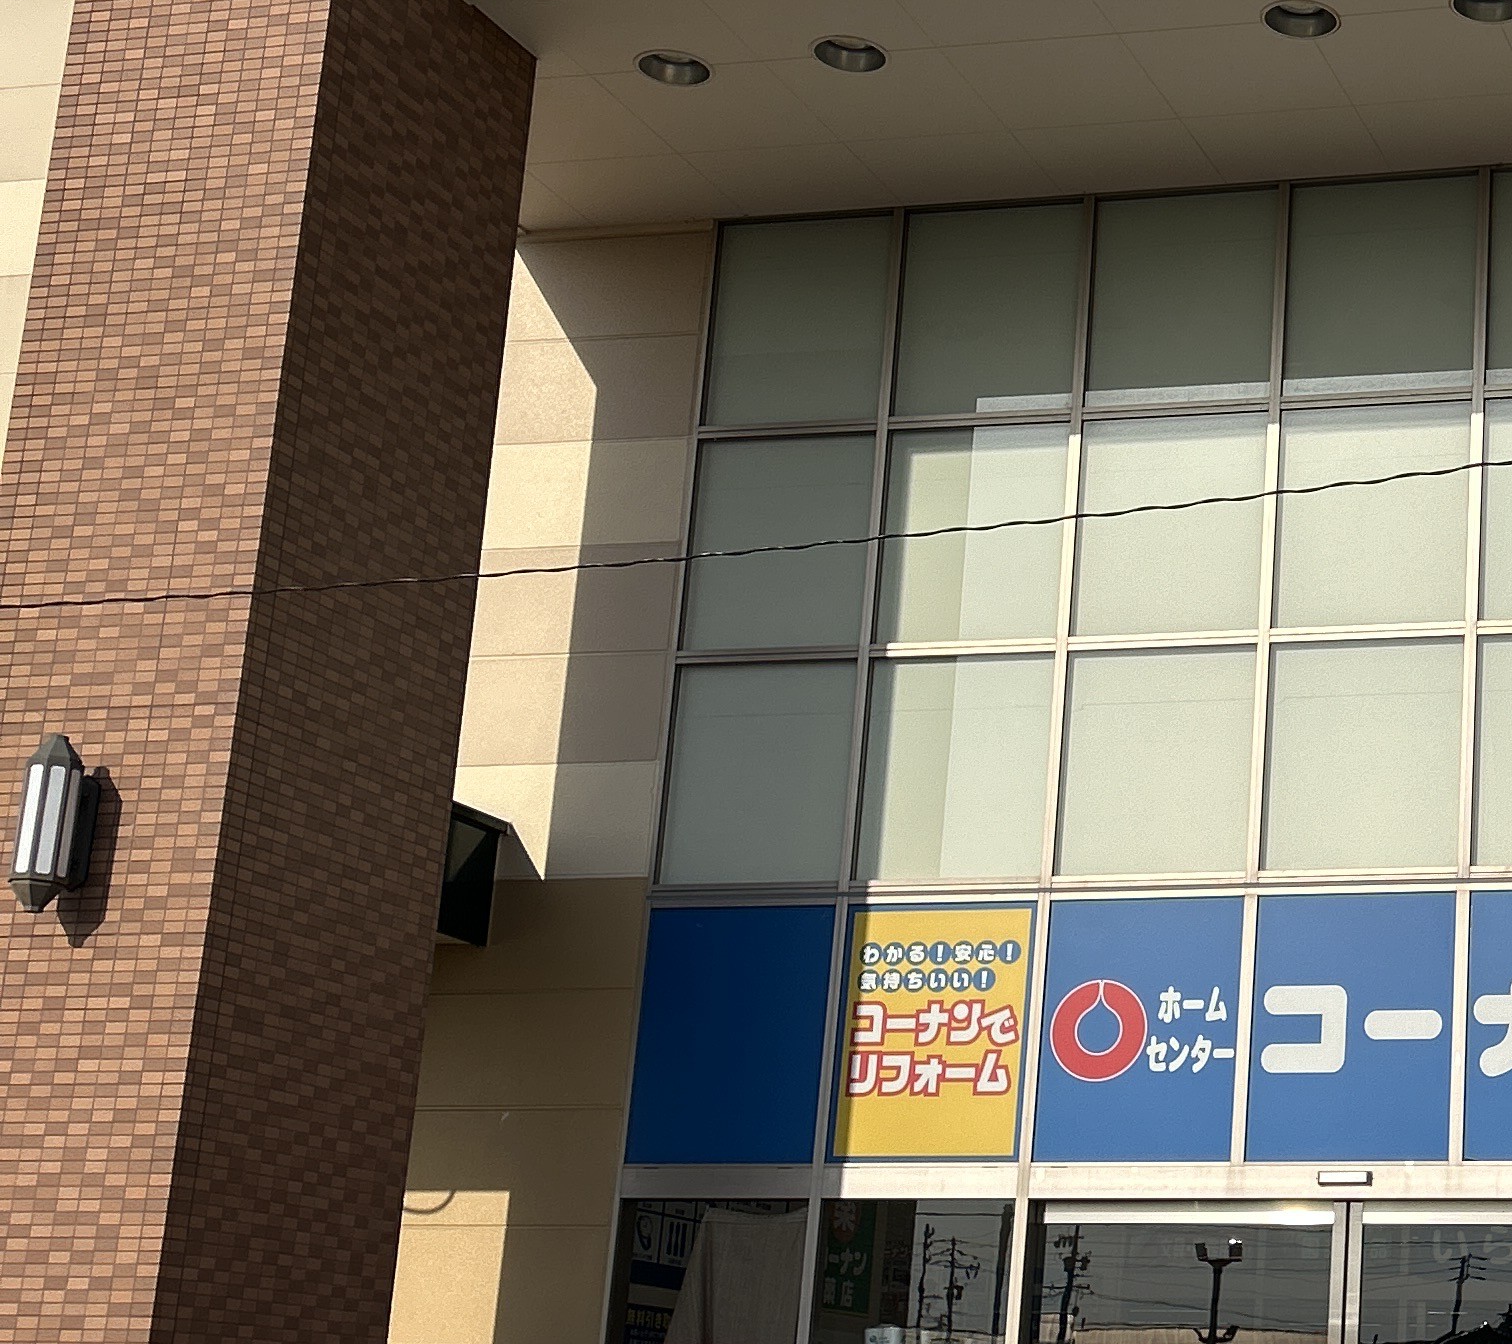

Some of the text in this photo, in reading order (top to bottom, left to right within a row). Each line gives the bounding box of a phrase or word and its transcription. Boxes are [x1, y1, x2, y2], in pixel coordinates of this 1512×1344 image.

[862, 941, 1014, 965] わかる！安心！
[859, 969, 989, 991] 気持ちいい！
[850, 999, 1020, 1047] コーナンで
[1157, 985, 1228, 1025] ホーム
[846, 1049, 1012, 1097] リフォーム
[1146, 1032, 1236, 1074] センター
